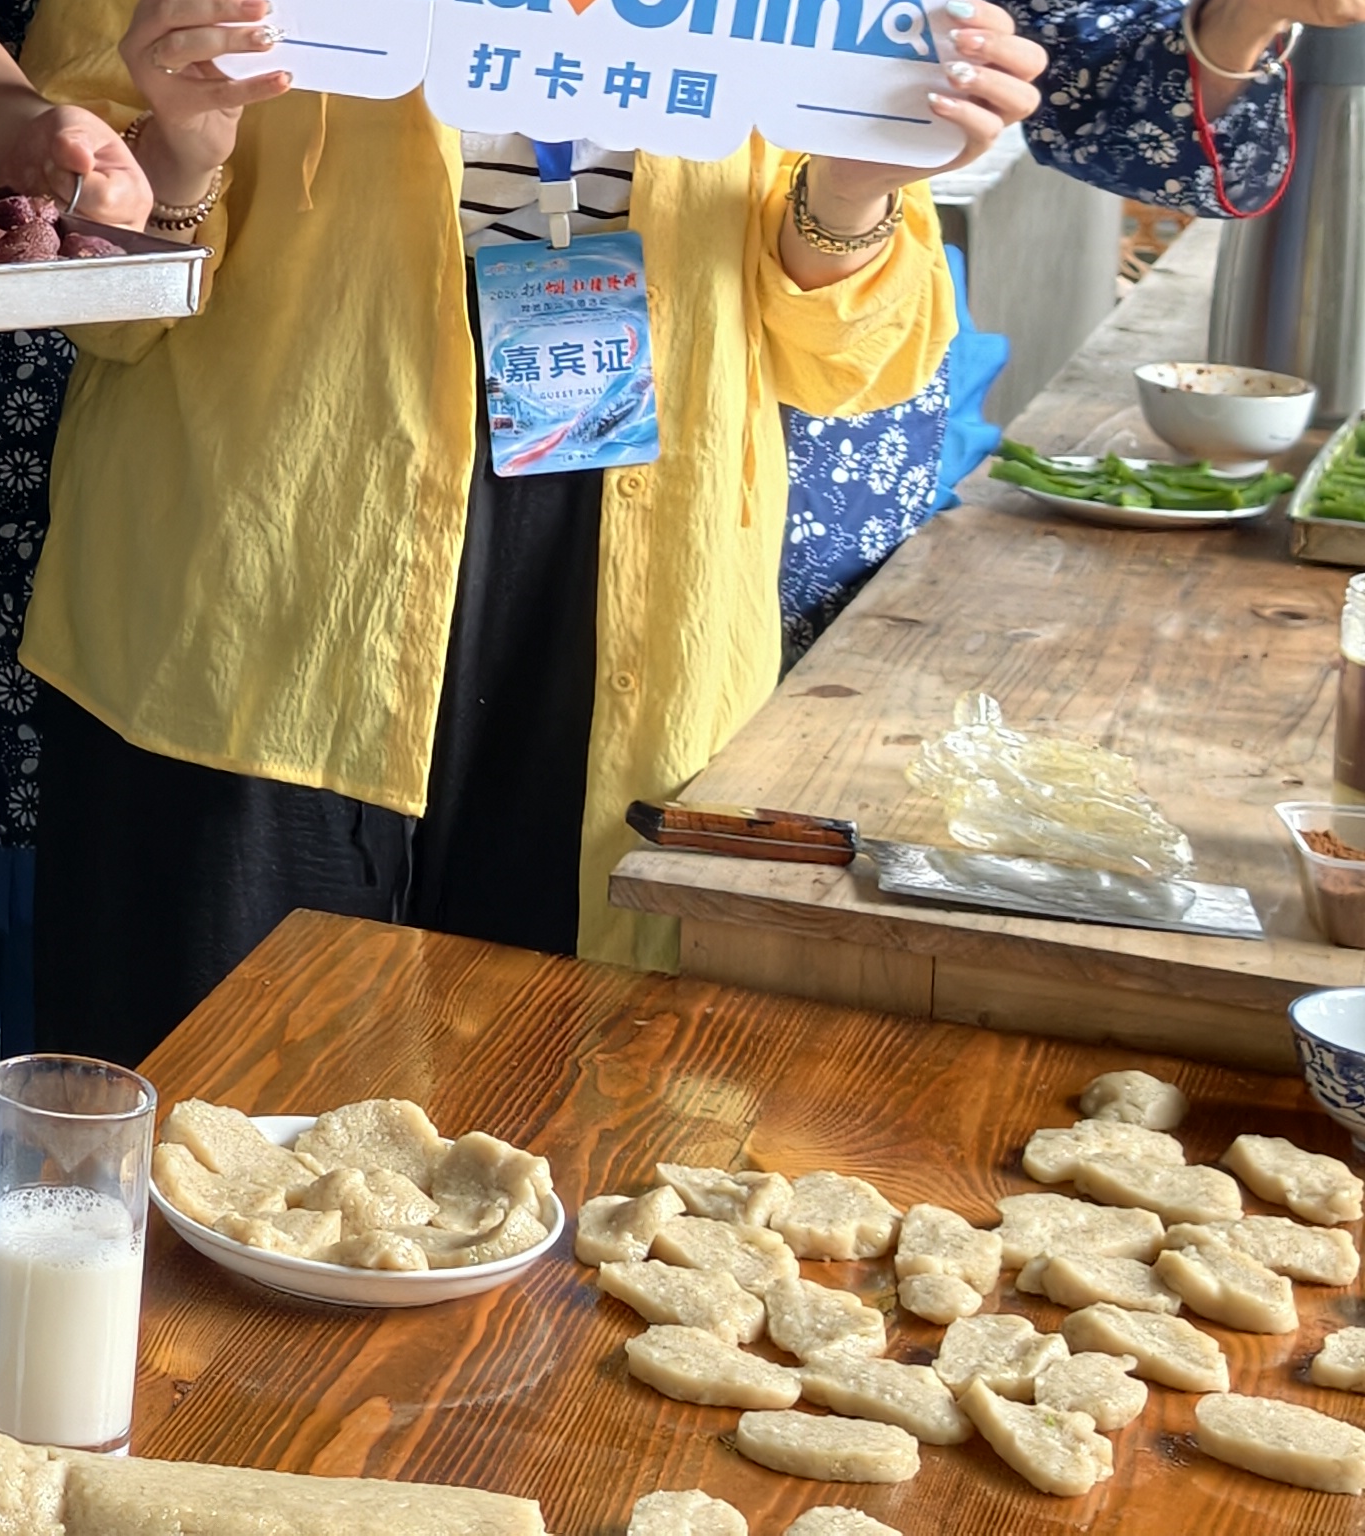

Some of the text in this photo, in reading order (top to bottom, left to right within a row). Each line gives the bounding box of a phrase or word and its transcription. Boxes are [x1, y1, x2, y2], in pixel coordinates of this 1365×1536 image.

[468, 43, 718, 119] 打卡中国
[502, 337, 633, 384] 嘉宾证
[539, 387, 604, 400] GUEST PASS
